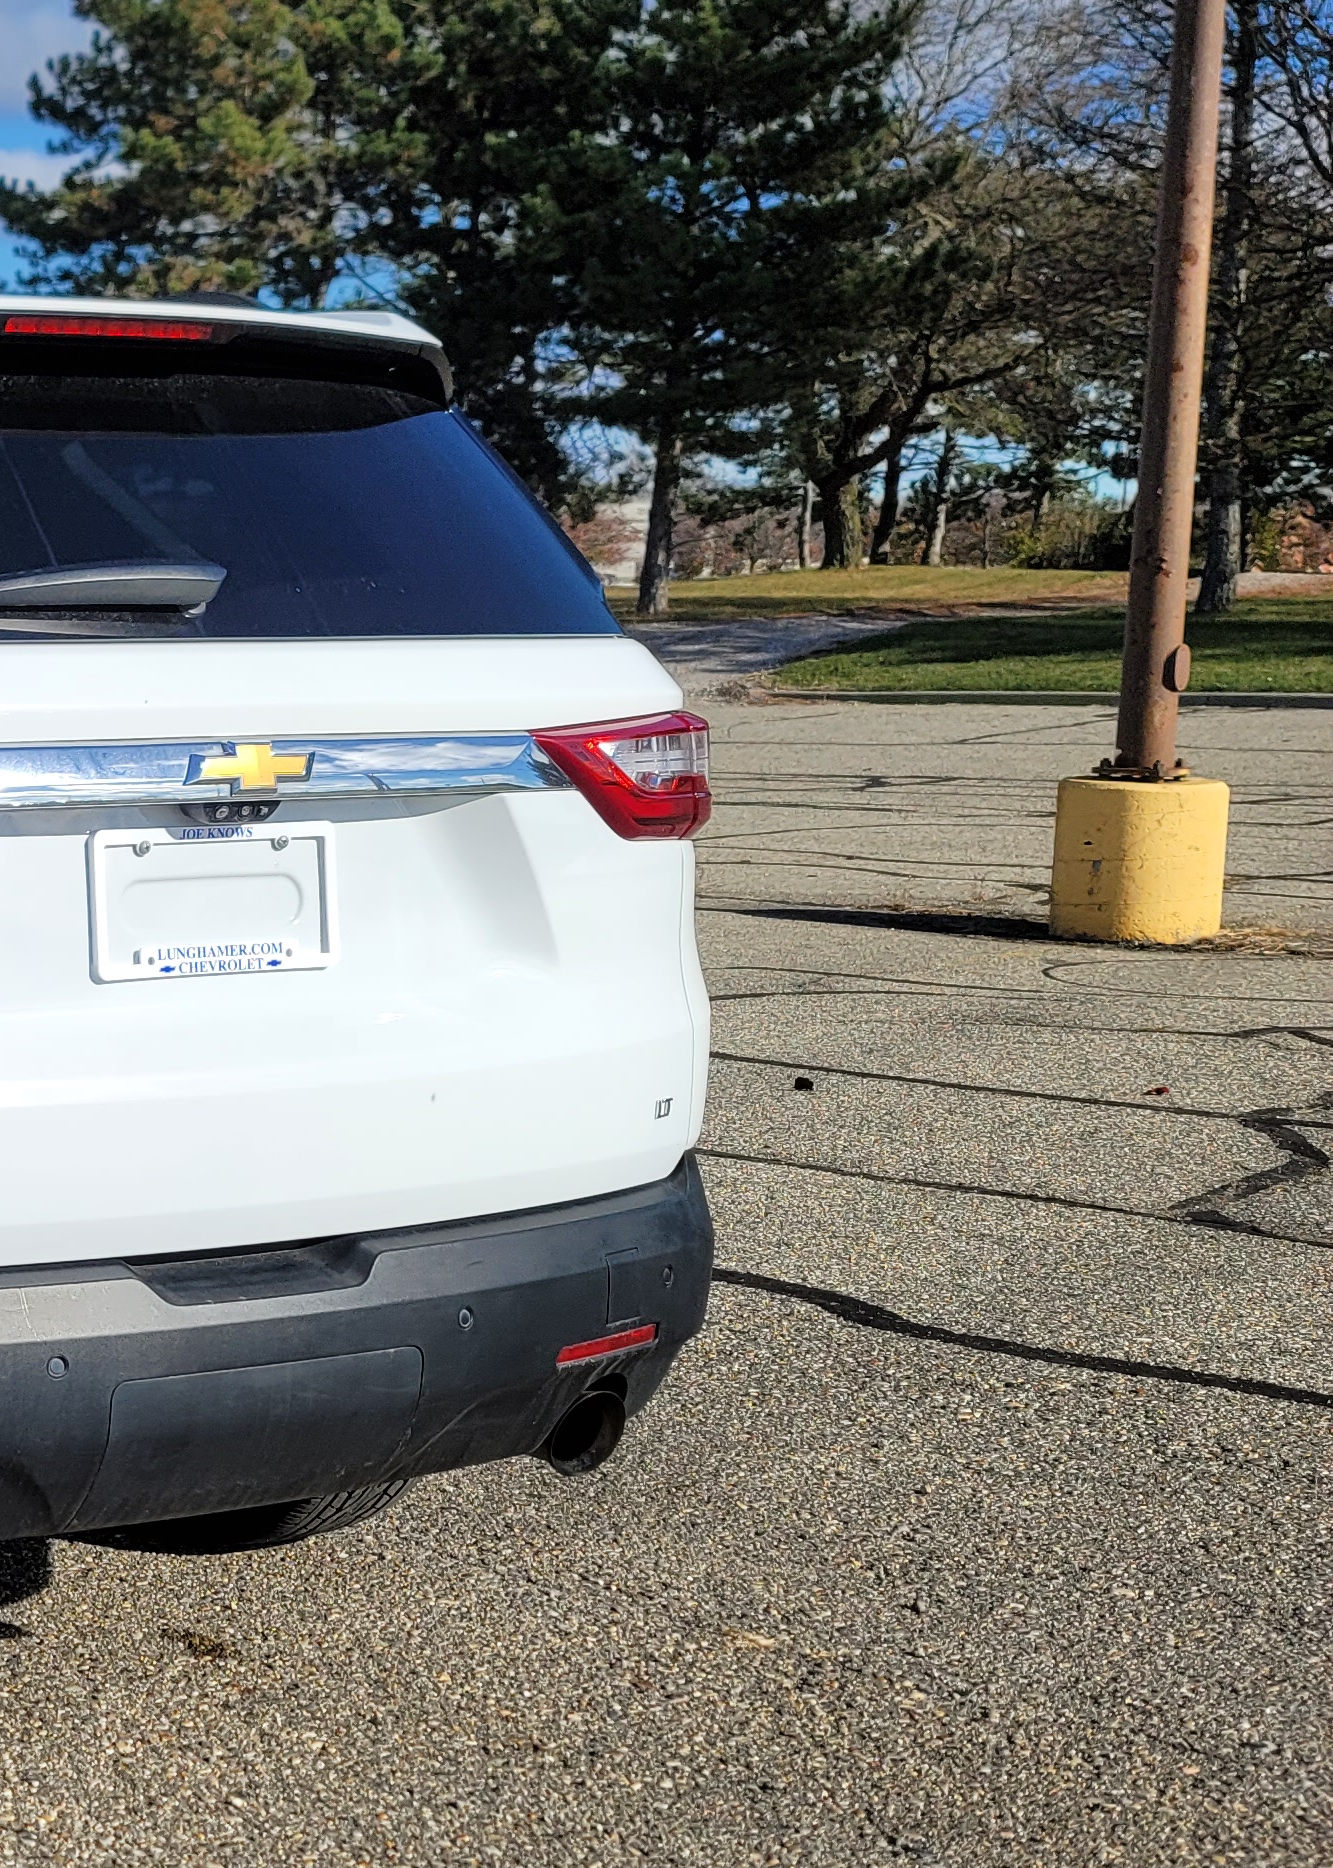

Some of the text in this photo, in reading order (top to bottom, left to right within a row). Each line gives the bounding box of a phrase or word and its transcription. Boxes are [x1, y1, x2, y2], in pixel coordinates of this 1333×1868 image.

[180, 826, 253, 840] JOE KNOWS
[157, 941, 283, 961] LUNGHAMER.COM
[178, 957, 264, 974] CHEVROLET
